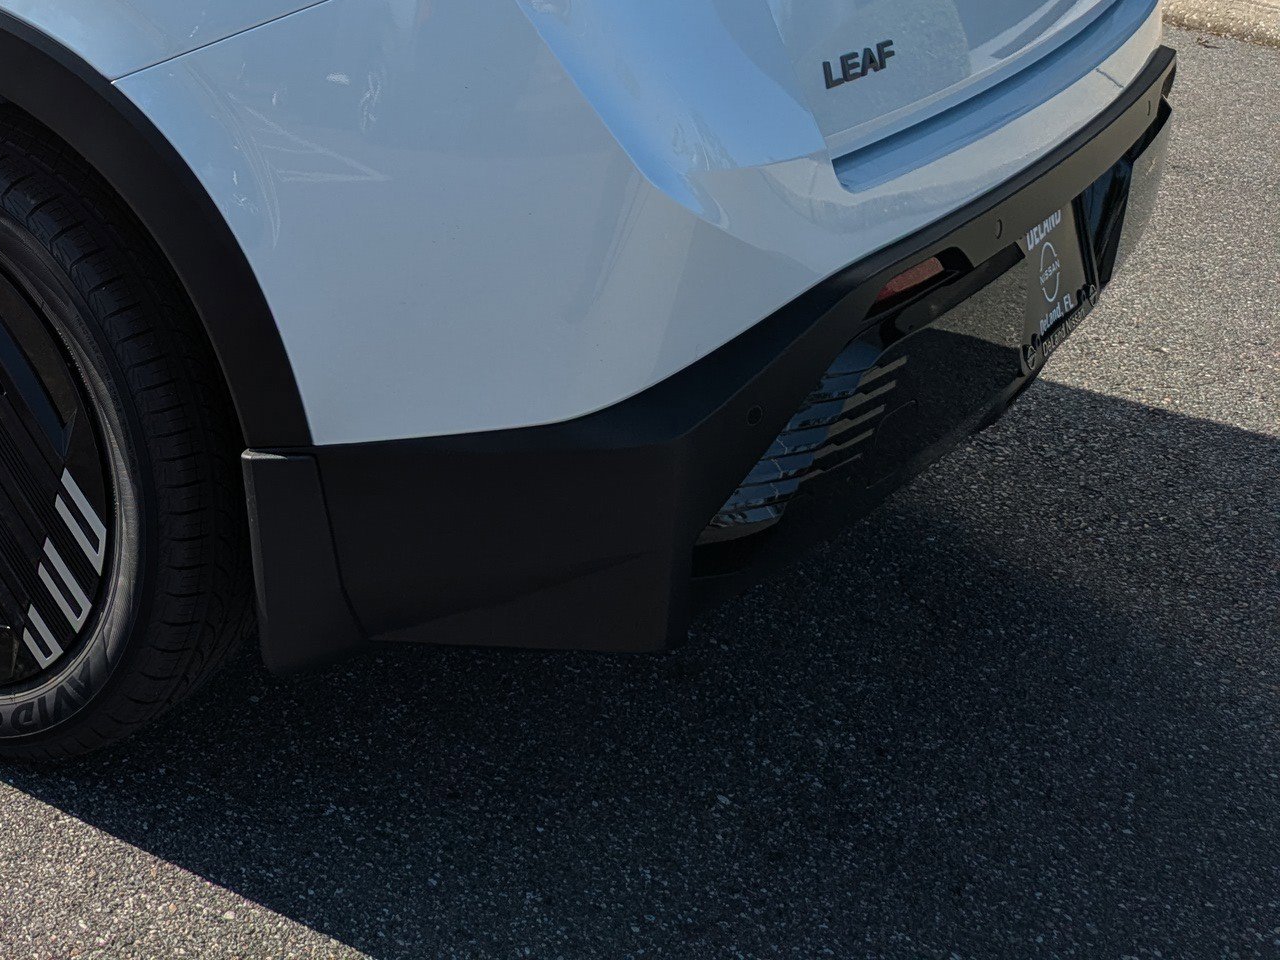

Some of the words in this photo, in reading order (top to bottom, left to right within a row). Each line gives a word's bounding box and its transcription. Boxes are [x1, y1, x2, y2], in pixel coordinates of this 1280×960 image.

[822, 40, 895, 89] LEAF
[1039, 259, 1060, 285] NISSAN
[1063, 293, 1074, 312] FL
